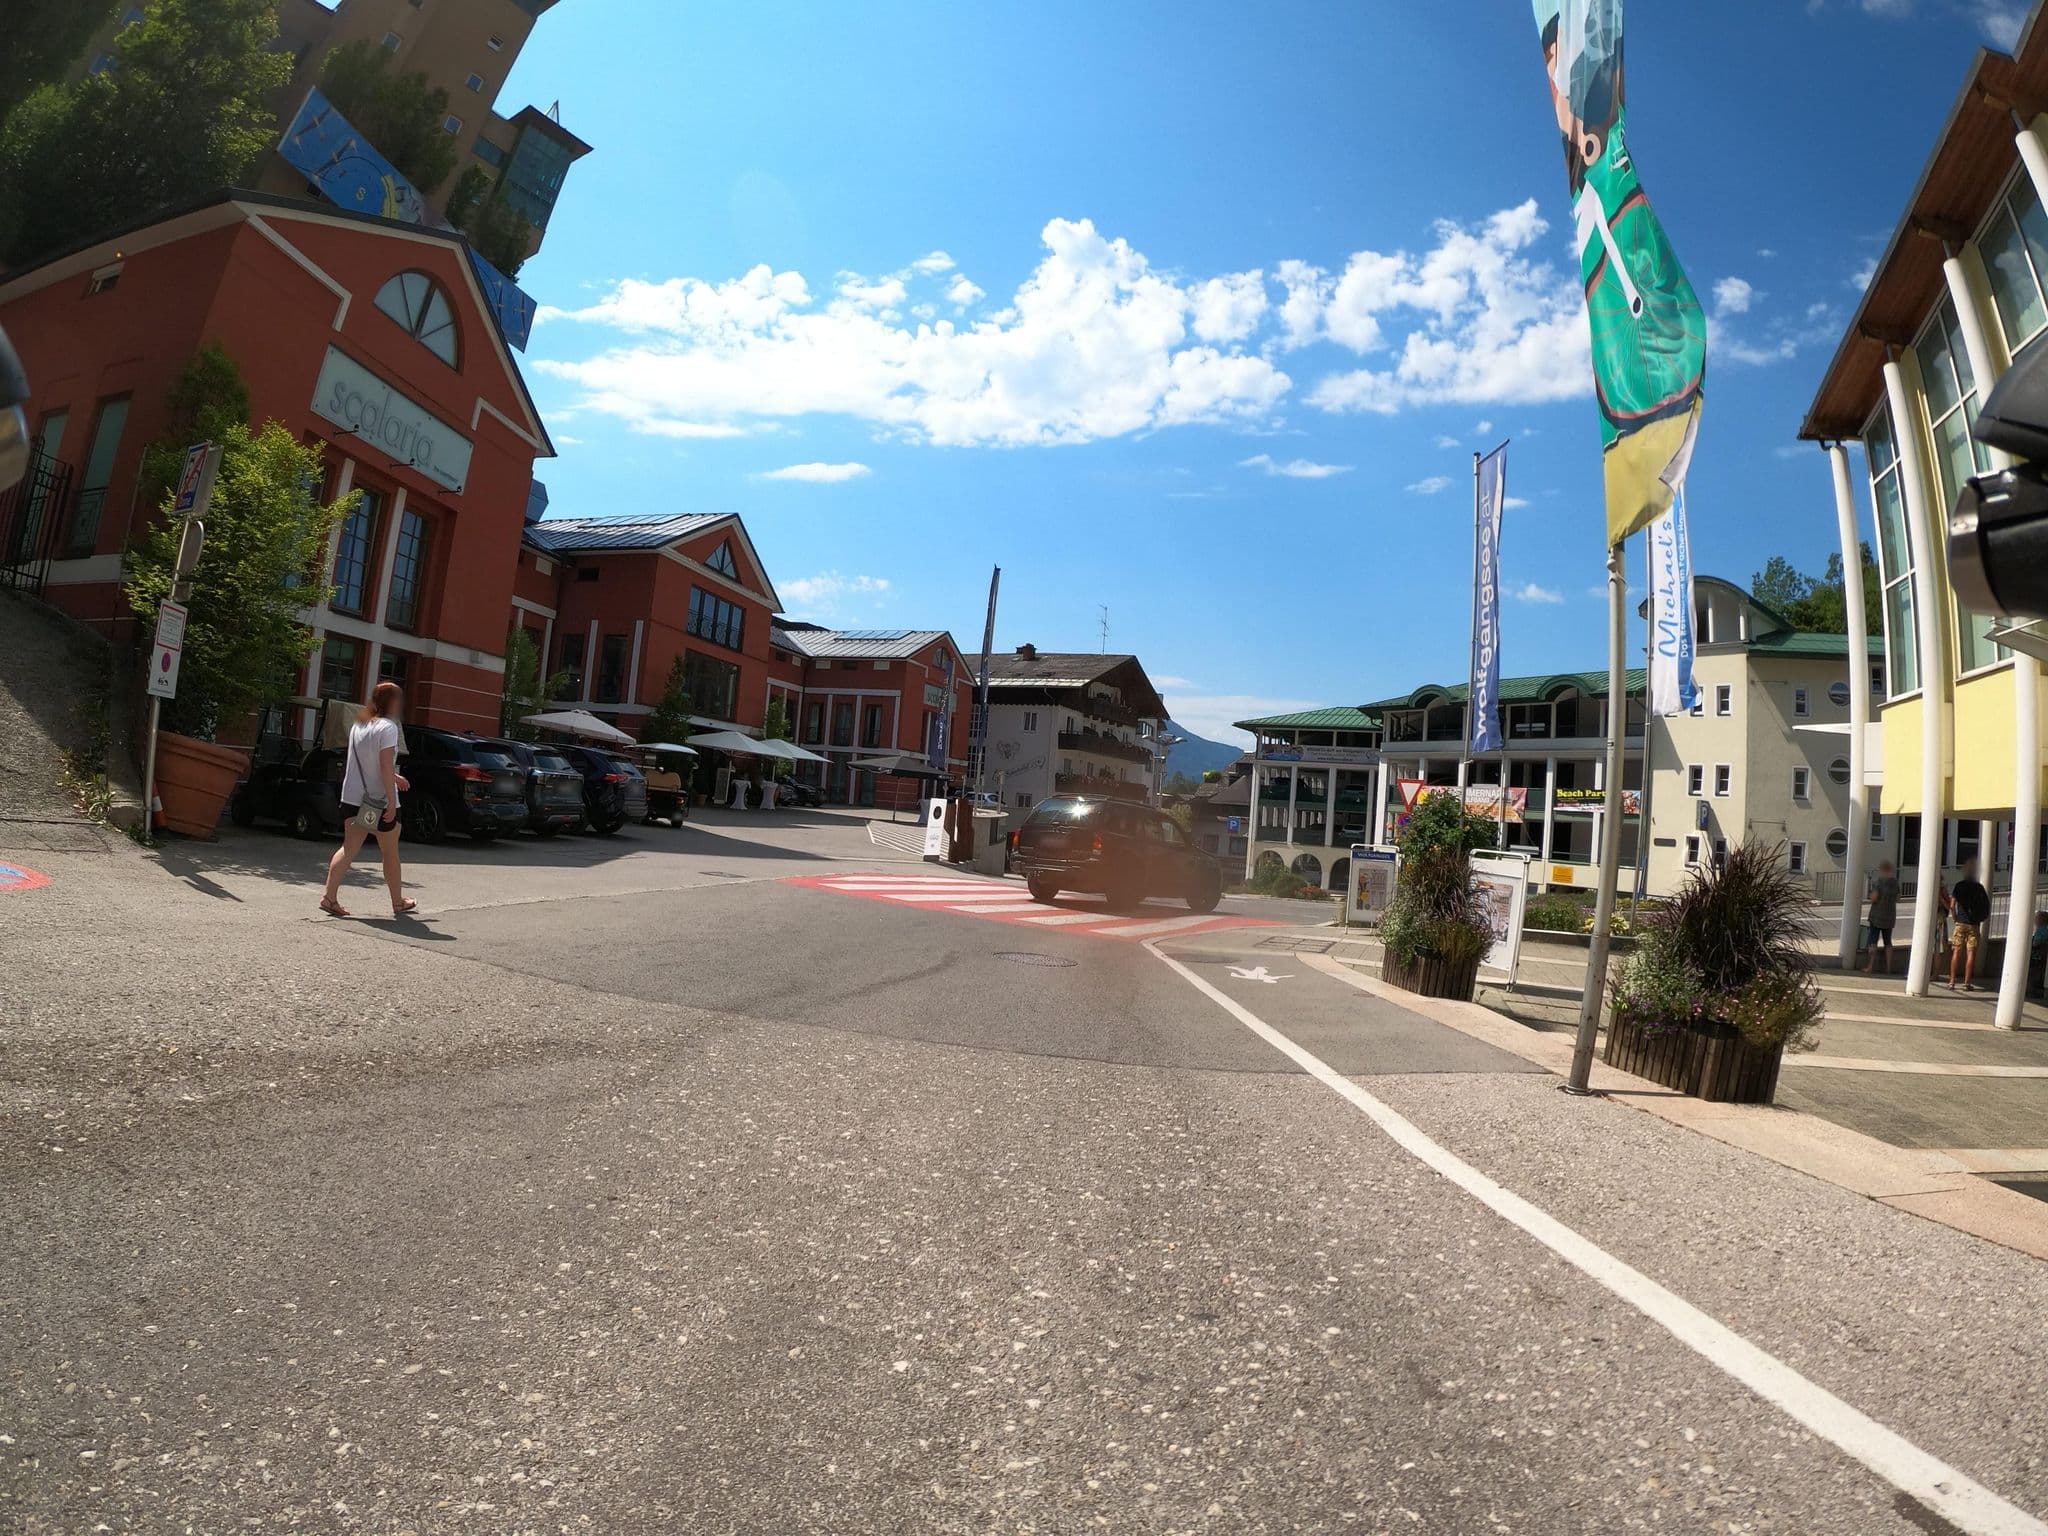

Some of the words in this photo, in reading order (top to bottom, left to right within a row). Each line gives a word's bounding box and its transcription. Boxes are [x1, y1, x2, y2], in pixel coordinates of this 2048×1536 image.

[330, 381, 432, 465] scalaria
[1476, 489, 1495, 738] wolfgangsee.at
[1658, 520, 1679, 657] Michael's
[1557, 789, 1584, 798] Beach
[1585, 789, 1607, 798] Part
[1702, 806, 1708, 824] P
[1229, 821, 1238, 830] P
